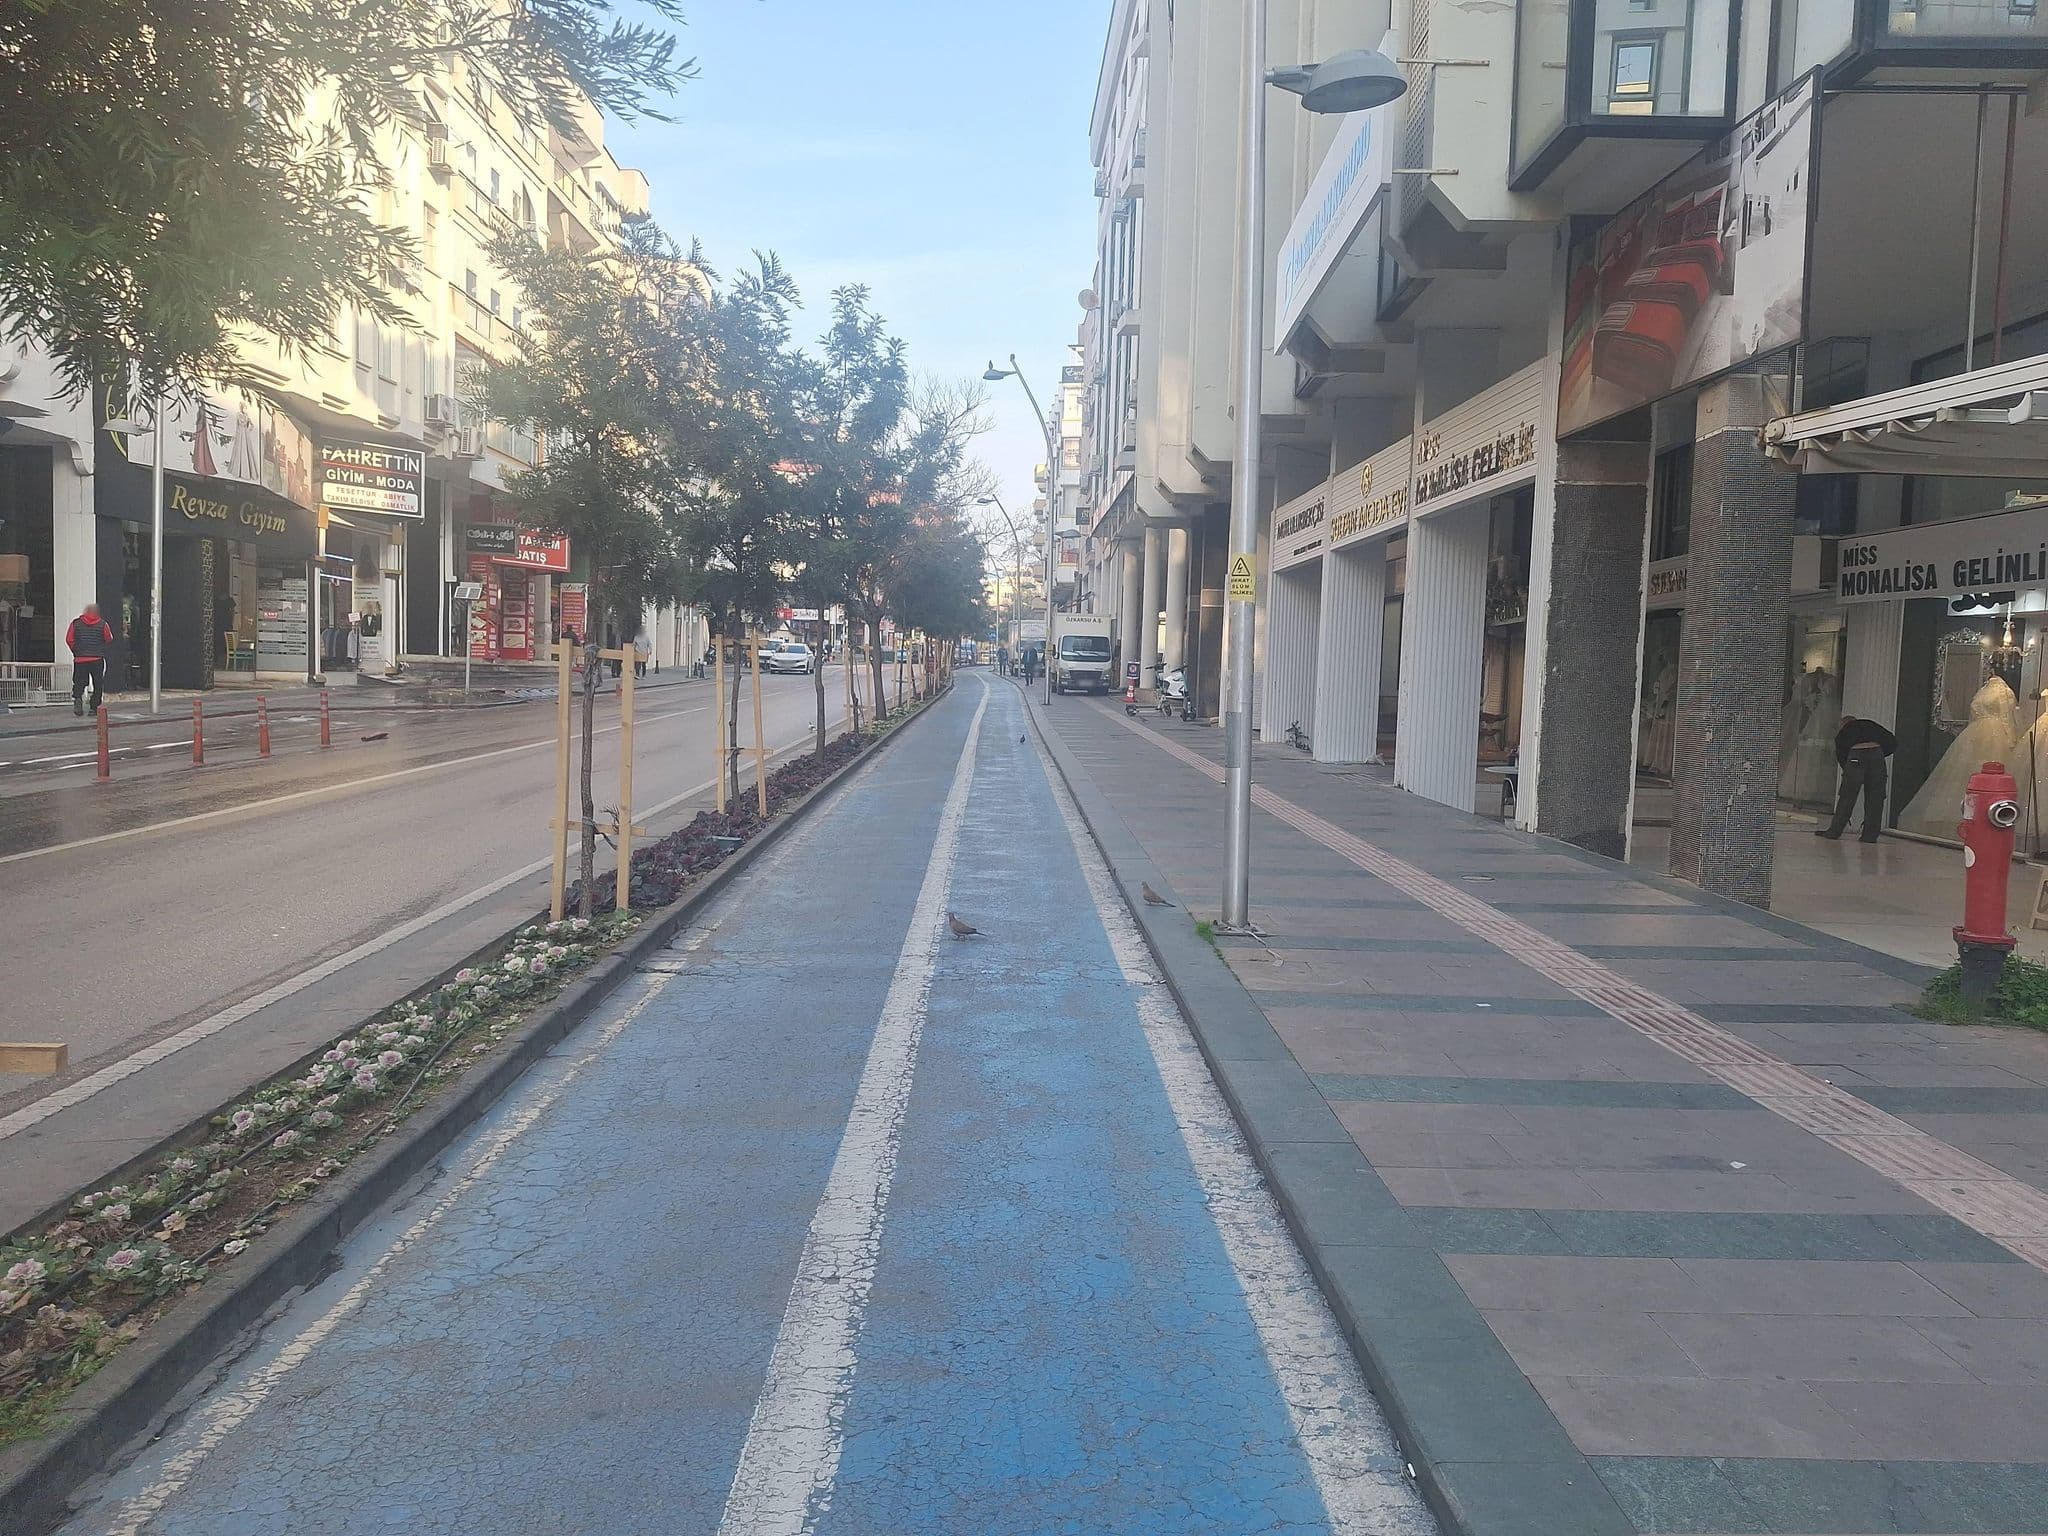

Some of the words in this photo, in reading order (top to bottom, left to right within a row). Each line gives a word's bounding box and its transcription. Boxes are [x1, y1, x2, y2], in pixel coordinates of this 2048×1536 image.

[326, 467, 365, 484] GİYİM
[376, 475, 415, 491] MODA
[171, 484, 229, 519] Revza
[1843, 543, 1878, 567] MİSS
[1841, 560, 1938, 597] MONALİSA
